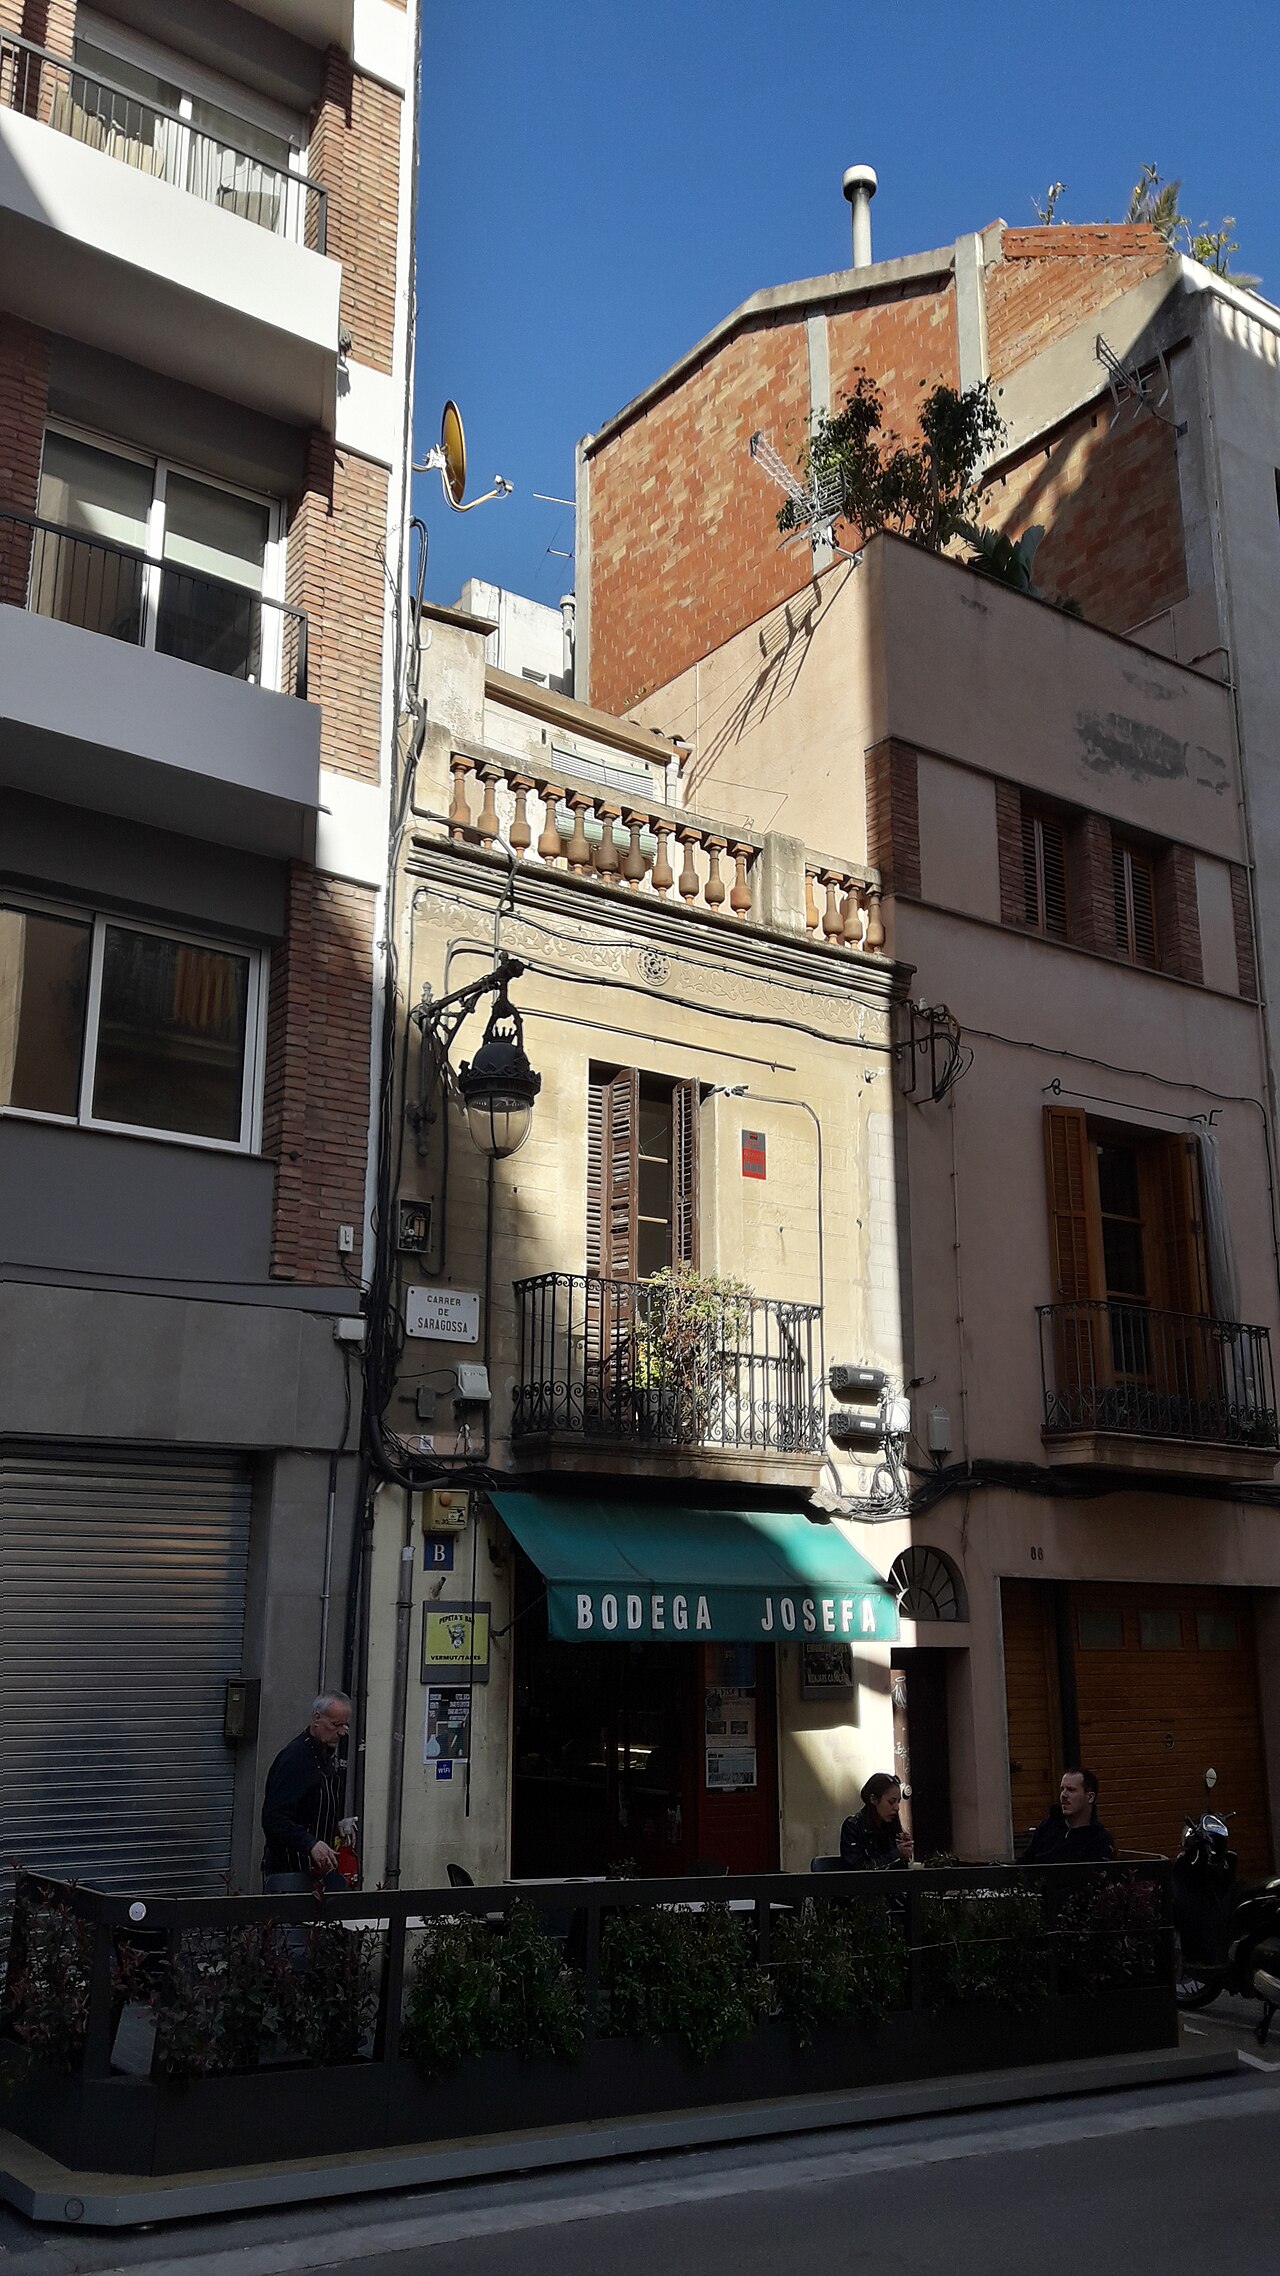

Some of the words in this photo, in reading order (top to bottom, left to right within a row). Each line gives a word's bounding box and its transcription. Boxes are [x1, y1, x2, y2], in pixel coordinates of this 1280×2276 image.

[427, 1295, 461, 1306] CARRER
[438, 1308, 449, 1316] DE
[417, 1317, 468, 1333] SARAGOSSA
[433, 1544, 446, 1562] B
[1030, 1546, 1043, 1560] 88
[439, 1614, 463, 1624] PEPETA'S
[577, 1593, 713, 1630] BODEGA
[761, 1597, 877, 1632] JOSEFA
